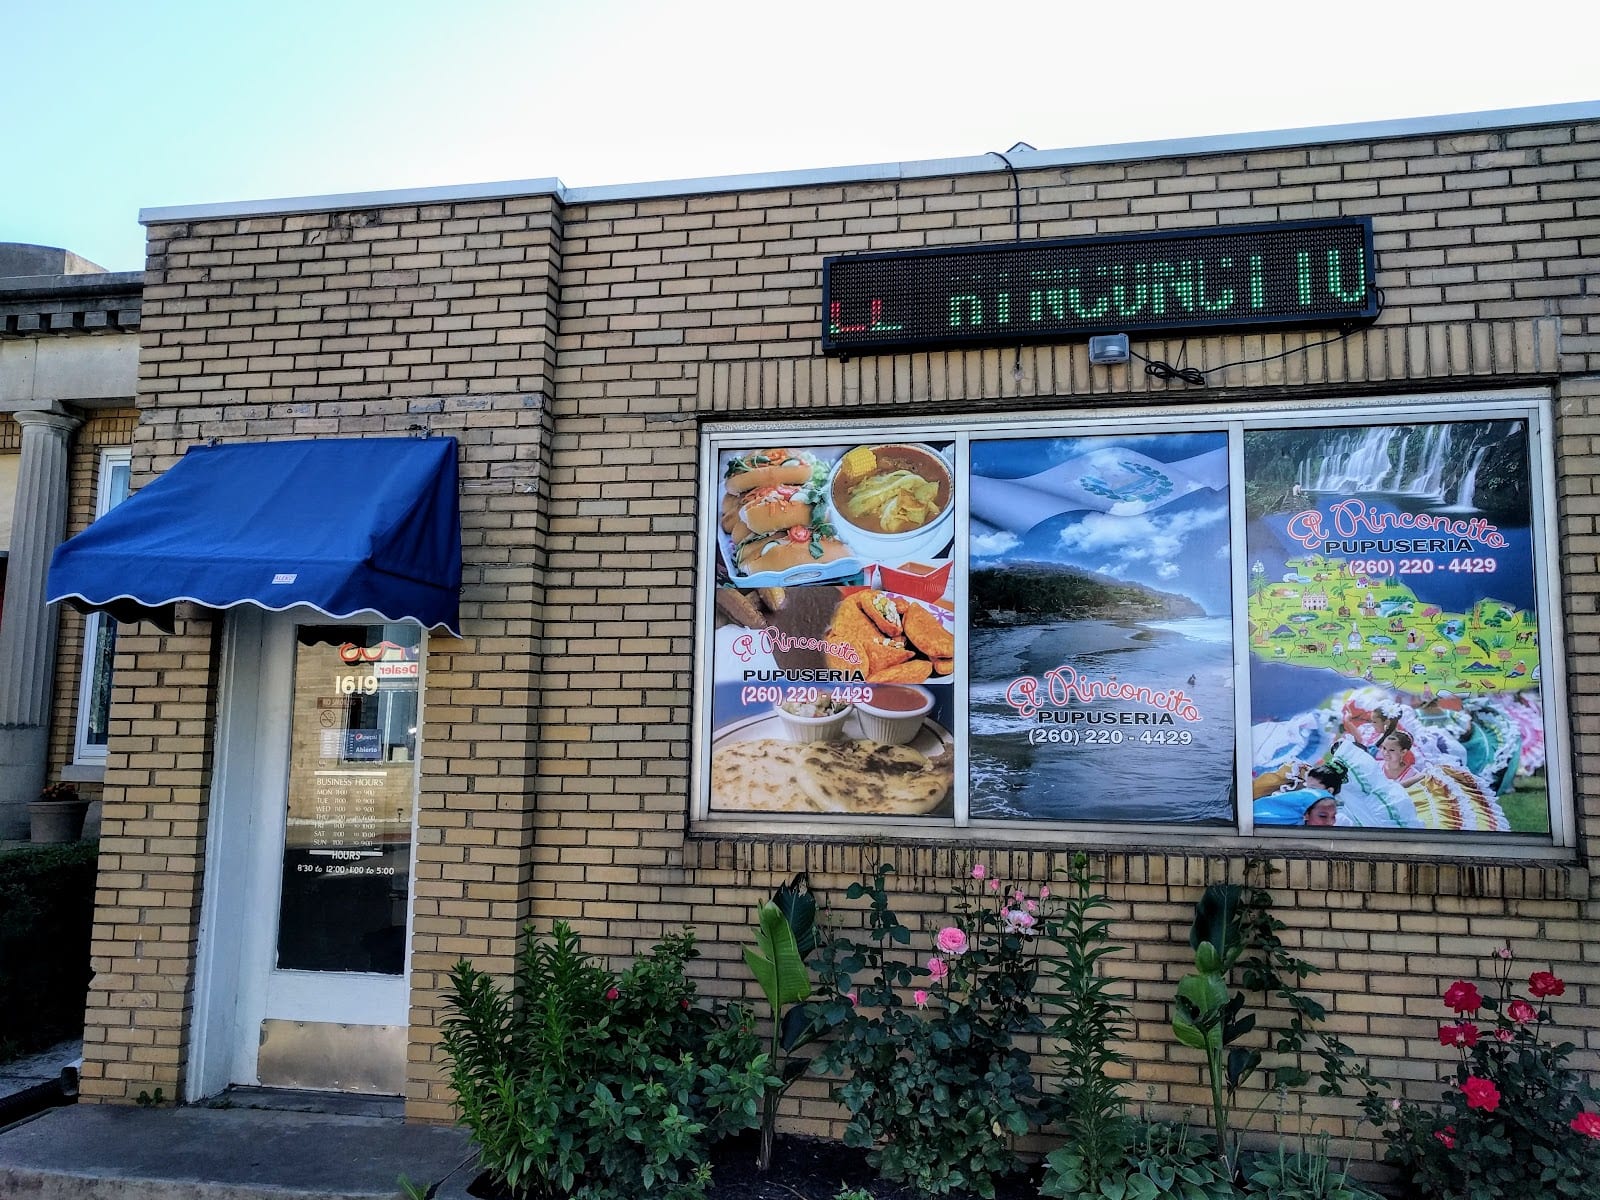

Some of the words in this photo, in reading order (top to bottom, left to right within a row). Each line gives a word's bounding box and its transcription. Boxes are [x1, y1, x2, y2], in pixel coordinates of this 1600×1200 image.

[1287, 509, 1330, 549] El
[1330, 498, 1509, 548] Rinconcito
[1325, 538, 1474, 554] PUPUSERIA
[1349, 559, 1394, 576] (260)
[1399, 559, 1434, 574] 220
[1448, 558, 1496, 573] 4429
[732, 634, 756, 662] El
[758, 626, 862, 664] Rinconcito
[744, 669, 864, 682] PUPUSERIA
[335, 676, 378, 696] 1619
[1006, 676, 1042, 717] El
[1044, 666, 1203, 722] Rinconcito
[741, 686, 782, 706] (260)
[786, 686, 818, 703] 220
[831, 686, 873, 703] 4429
[1038, 711, 1175, 726] PUPUSERIA
[1028, 728, 1080, 746] (260)
[1084, 730, 1123, 744] 220
[1140, 730, 1192, 745] 4429
[316, 778, 352, 786] BUSINESS
[355, 778, 384, 786] HOURS
[332, 850, 360, 860] HOURS
[314, 865, 323, 873] to
[366, 866, 374, 874] to
[376, 867, 395, 875] 5:00
